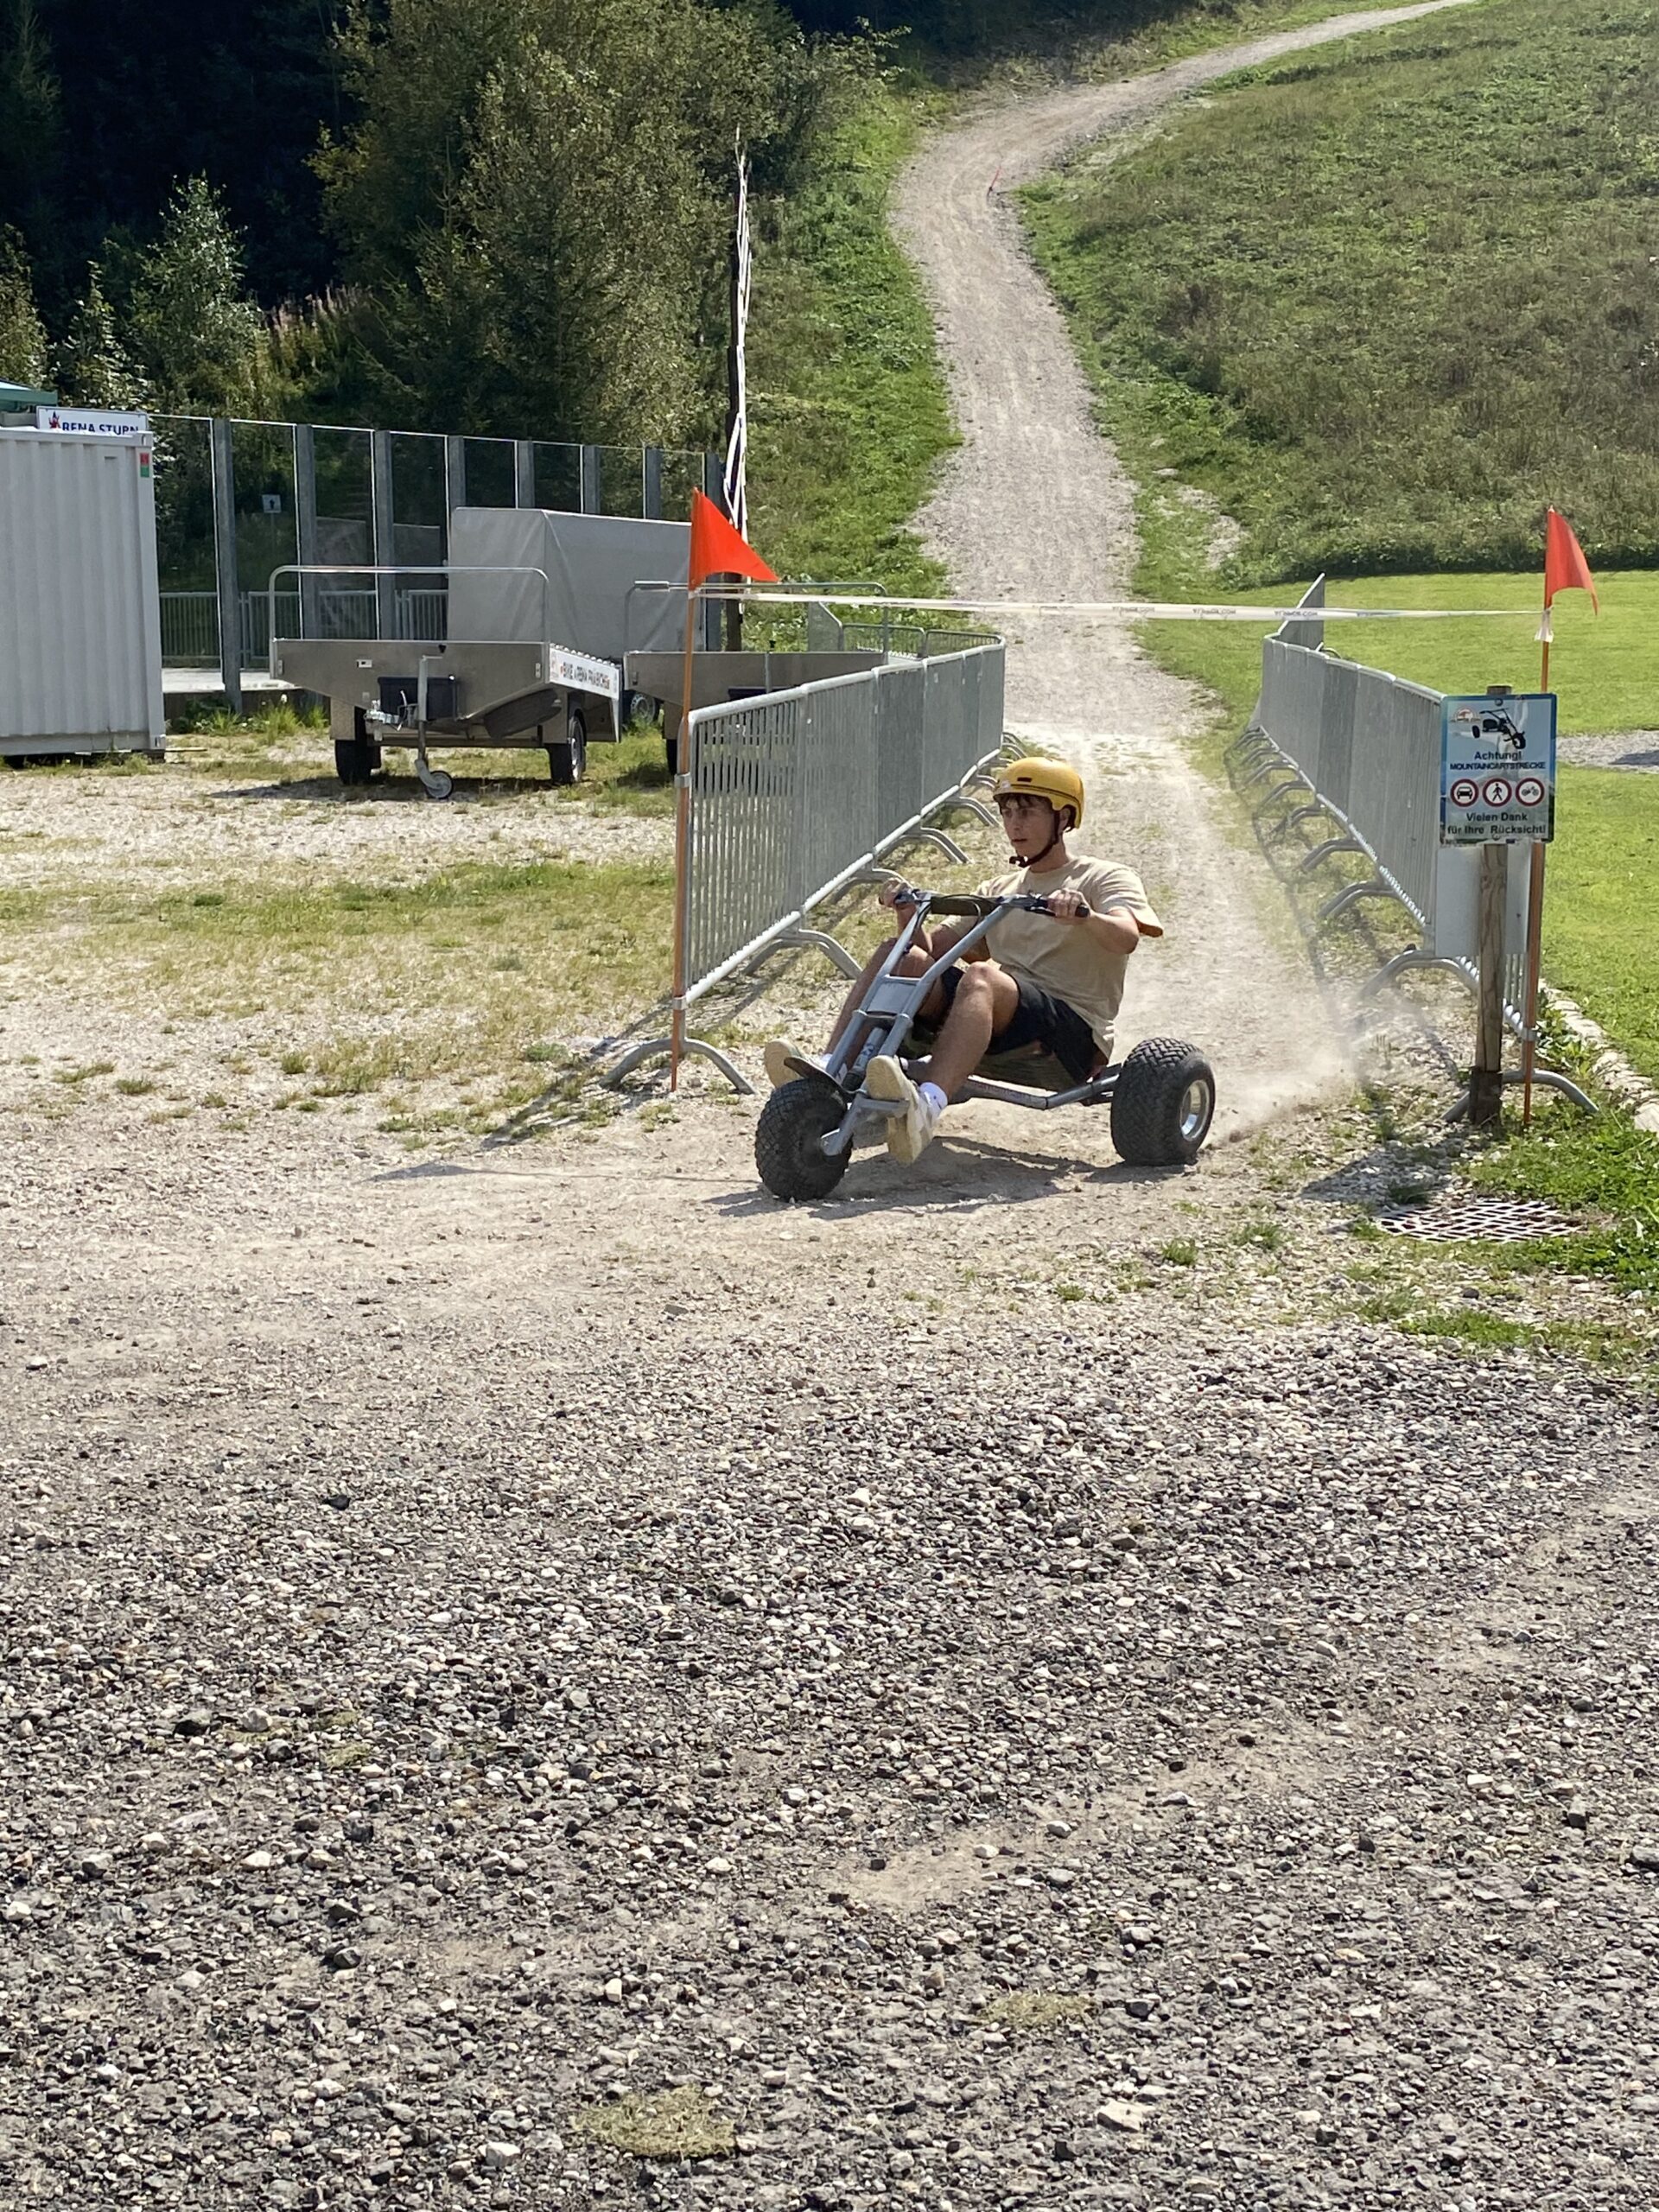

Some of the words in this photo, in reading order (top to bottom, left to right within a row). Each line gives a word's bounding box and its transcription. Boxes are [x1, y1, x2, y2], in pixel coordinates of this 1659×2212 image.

[1474, 751, 1522, 760] Achtung!
[1450, 761, 1546, 770] MOUNTAINCARTSTRECKE
[1466, 812, 1498, 822] Vielen
[1501, 812, 1529, 822] Dank
[1447, 825, 1462, 834] für
[1491, 825, 1546, 834] Rücksicht!
